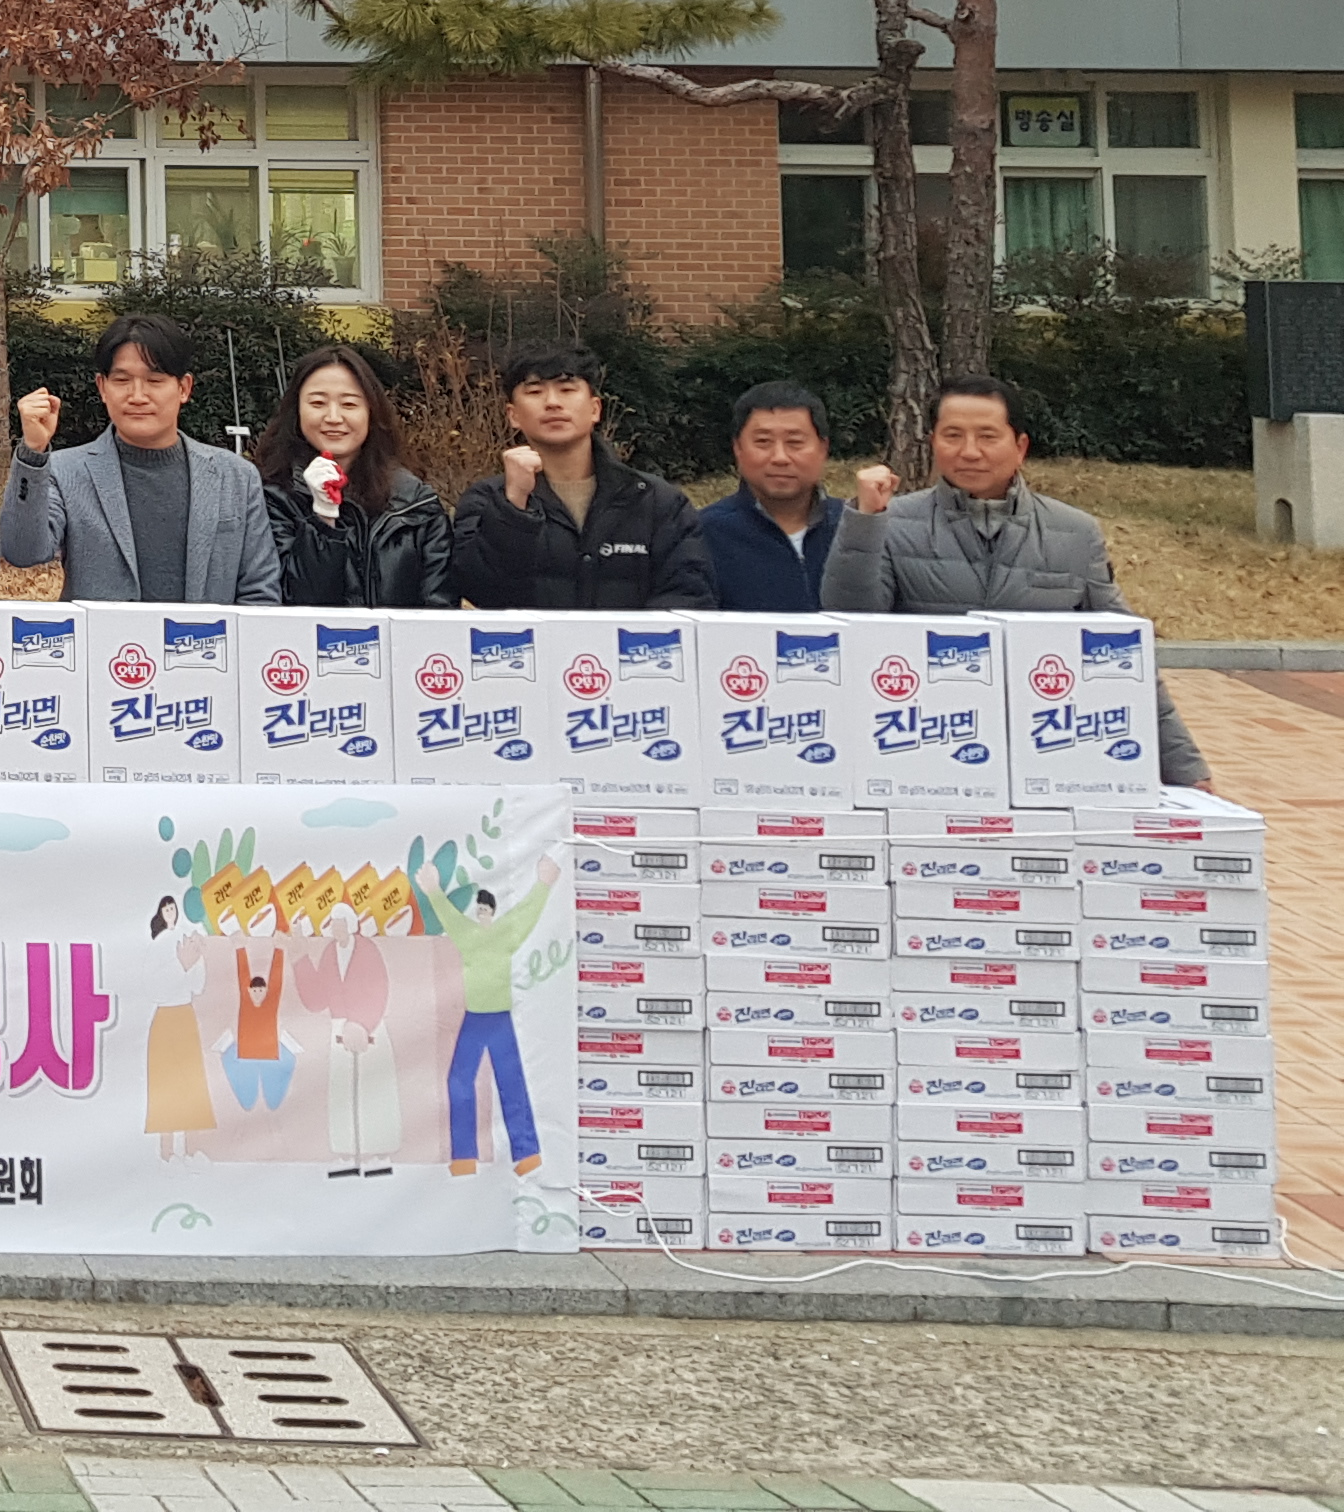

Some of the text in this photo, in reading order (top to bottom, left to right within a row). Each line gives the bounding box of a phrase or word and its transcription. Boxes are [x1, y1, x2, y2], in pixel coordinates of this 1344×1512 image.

[1015, 109, 1075, 133] 방송실
[614, 543, 648, 555] FINAL
[116, 664, 148, 679] 오뚜기
[269, 670, 301, 685] 오뚜기
[109, 693, 213, 743] 진라면
[263, 699, 367, 749] 진라면
[416, 703, 522, 753] 진라면
[566, 702, 670, 753] 진라면
[720, 705, 826, 755] 진라면
[871, 705, 979, 756] 진라면
[1031, 703, 1131, 753] 진라면
[214, 881, 232, 905] 라면
[244, 885, 264, 909] 라면
[287, 881, 305, 906] 라면
[315, 885, 337, 910] 라면
[352, 882, 370, 907] 라면
[381, 887, 403, 912] 라면
